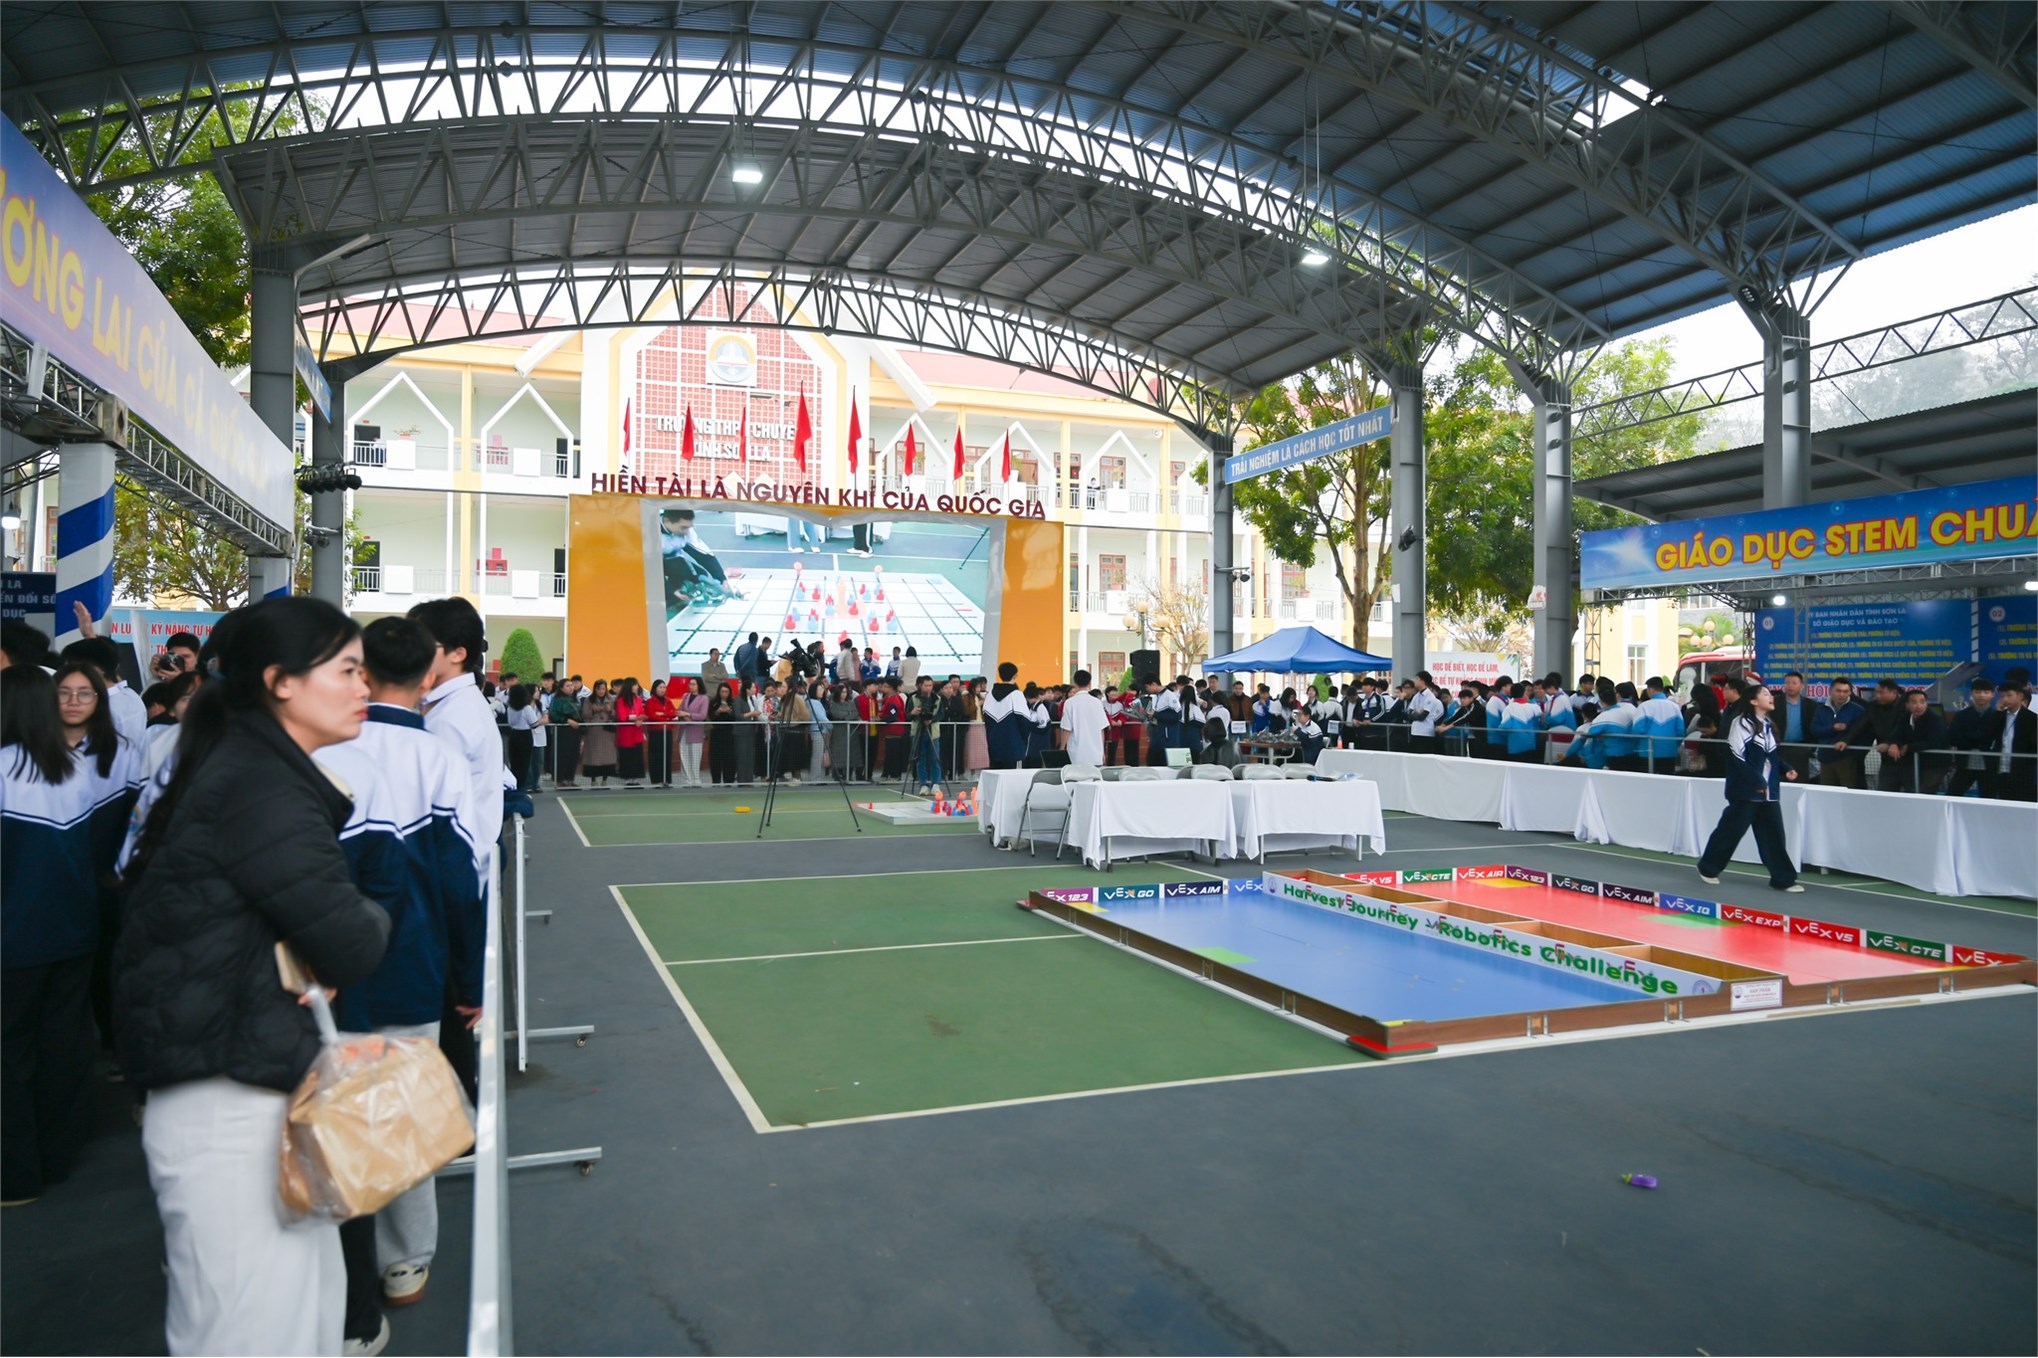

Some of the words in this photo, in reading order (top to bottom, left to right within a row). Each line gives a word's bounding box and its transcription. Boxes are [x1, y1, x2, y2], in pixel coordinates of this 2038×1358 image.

[0, 165, 84, 331] ƠNG
[92, 276, 132, 373] LAI
[137, 319, 178, 417] CỦA
[1231, 458, 1247, 476] TRẢI
[1249, 449, 1279, 470] NGHIỆM
[1282, 447, 1291, 461] LÀ
[1293, 440, 1316, 457] CÁCH
[1318, 432, 1336, 450] HỌC
[1339, 421, 1355, 443] TỐT
[1358, 414, 1383, 438] NHẤT
[591, 465, 647, 495] HIỀN
[655, 472, 692, 498] TÀI
[701, 475, 728, 500] LÀ
[736, 480, 829, 505] NGUYÊN
[839, 485, 876, 508] KHÍ
[883, 486, 930, 511] CỦA
[937, 489, 1002, 515] QUỐC
[1008, 498, 1046, 519] GIA
[1655, 530, 1734, 571] GIÁO
[1742, 527, 1816, 570] DỤC
[1825, 515, 1918, 556] STEM
[1830, 609, 1848, 617] NHÂN
[1866, 608, 1881, 616] TỈNH
[151, 621, 163, 635] KỸ
[1823, 618, 1840, 627] GIÁO
[1841, 619, 1855, 628] DỤC
[1857, 617, 1866, 626] VÀ
[1884, 617, 1898, 626] TẠO
[1404, 872, 1429, 882] VEX
[1458, 868, 1485, 879] VEX
[1486, 870, 1503, 878] AIR
[1508, 869, 1529, 880] VEX
[1104, 886, 1136, 899] VEX
[1137, 888, 1155, 898] GO
[1166, 884, 1198, 896] VEX
[1198, 884, 1221, 895] AIM
[1556, 878, 1579, 890] VEX
[1581, 885, 1594, 893] GO
[1046, 891, 1066, 902] EX
[1068, 894, 1089, 902] 123
[1605, 887, 1631, 900] VEX
[1633, 895, 1653, 904] AIM
[1666, 898, 1695, 912] VEX
[1696, 905, 1711, 915] IQ
[1723, 909, 1754, 923] VEX
[1755, 916, 1782, 927] EXP
[1794, 921, 1832, 939] VEX
[1284, 883, 1343, 909] Harvest
[1348, 898, 1418, 931] Journey
[1439, 921, 1532, 957] Robotics
[1540, 946, 1678, 994] Challenge
[1869, 935, 1908, 952] VEX
[1909, 945, 1943, 958] CTE
